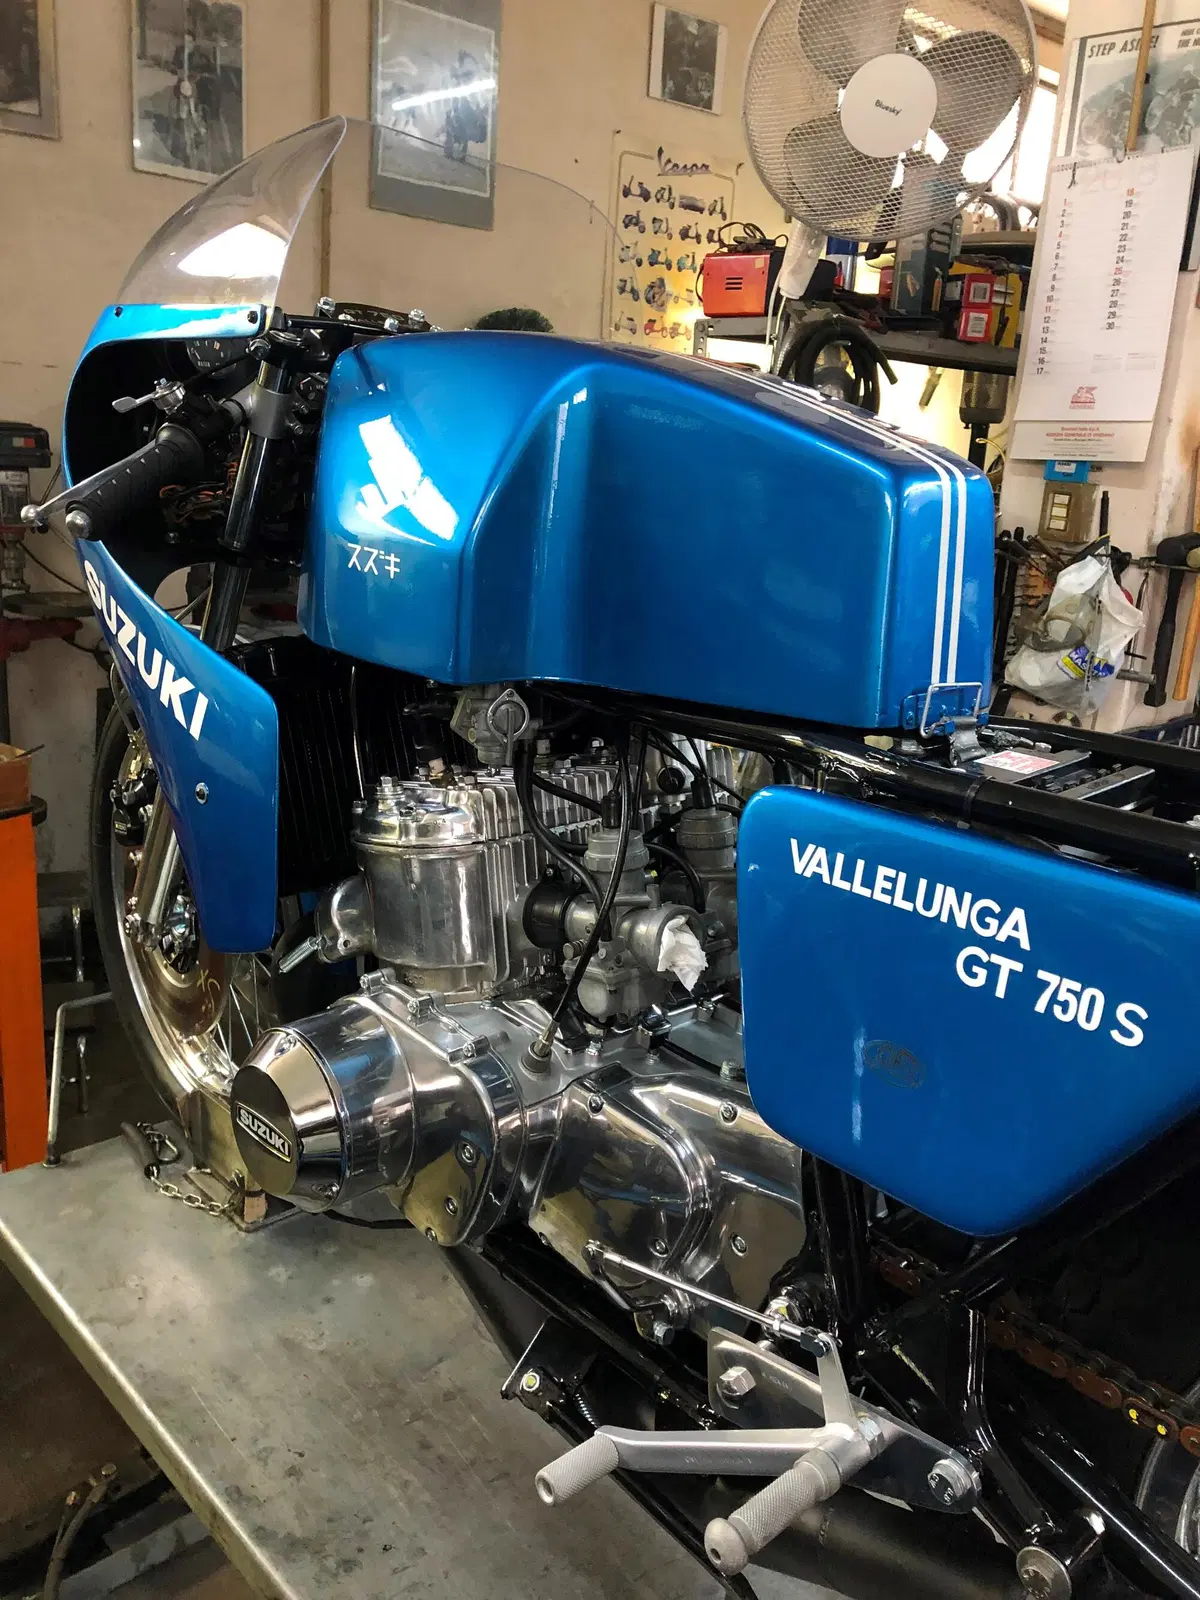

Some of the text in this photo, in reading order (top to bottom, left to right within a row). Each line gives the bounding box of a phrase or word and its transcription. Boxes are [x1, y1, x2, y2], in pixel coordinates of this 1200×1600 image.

[1088, 35, 1159, 58] STEP ASIE!
[1125, 199, 1133, 208] 19
[1123, 211, 1131, 219] 20
[1121, 222, 1129, 231] 21
[1119, 234, 1128, 242] 22
[1117, 244, 1126, 253] 23
[1115, 255, 1125, 264] 24
[1114, 267, 1123, 275] 25
[1112, 278, 1121, 286] 26
[1110, 289, 1119, 298] 27
[1046, 295, 1054, 303] 10
[1109, 300, 1118, 308] 28
[1045, 305, 1051, 313] 11
[1107, 311, 1116, 319] 29
[1043, 316, 1051, 324] 12
[1042, 326, 1049, 334] 13
[1106, 322, 1115, 330] 30
[1038, 357, 1045, 365] 16
[1036, 367, 1043, 375] 17
[347, 542, 401, 579] スズキ
[84, 560, 209, 741] SUZUKI
[790, 838, 1031, 951] VALLELUNGA
[955, 945, 1149, 1047] GT 750 S
[240, 1108, 289, 1156] SUZUKI
